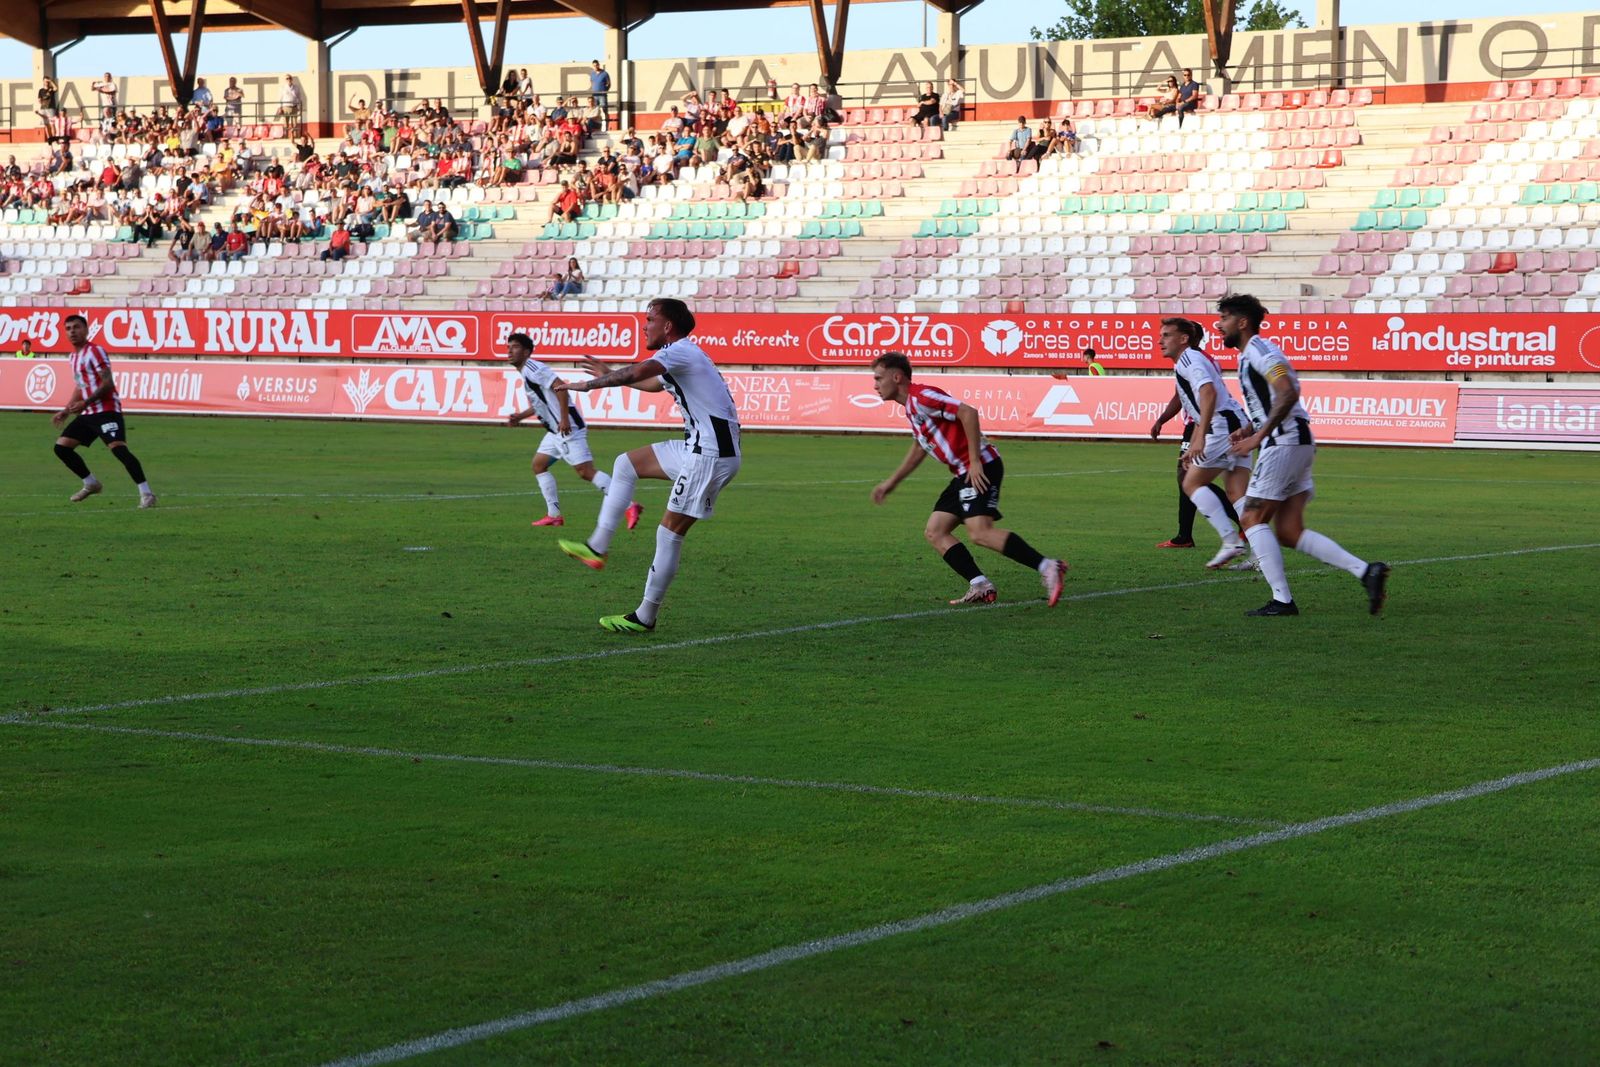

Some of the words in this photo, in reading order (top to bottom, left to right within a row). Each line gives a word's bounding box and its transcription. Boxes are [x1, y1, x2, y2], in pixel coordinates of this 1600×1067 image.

[870, 20, 1548, 105] AYUNTAMIENTO
[104, 309, 195, 351] CAJA
[204, 310, 341, 353] RURAL
[1026, 320, 1151, 329] ORTOPEDIA
[358, 316, 467, 353] AMAQ
[688, 334, 728, 346] orma
[732, 329, 800, 347] diferente
[1023, 333, 1069, 350] tres
[1077, 334, 1153, 350] cruces
[1372, 336, 1388, 350] la
[1392, 325, 1556, 351] industrial
[822, 349, 887, 357] EMBUTIDOS
[1446, 352, 1471, 366] de
[1475, 353, 1556, 368] pinturas
[112, 368, 203, 401] DERACIÓN
[253, 377, 318, 394] VERSUS
[727, 376, 791, 392] RNERA
[258, 395, 310, 403] E-LEARNING
[385, 369, 488, 415] CAJA
[498, 371, 656, 419] RAL
[735, 393, 791, 412] LISTE
[963, 390, 1022, 400] DENTAL
[977, 406, 1020, 420] AULA
[1094, 402, 1185, 421] AISLAPRI
[1299, 396, 1447, 417] VALDERADUEY
[1344, 418, 1393, 427] COMERCIAL
[1395, 419, 1407, 427] DE
[1409, 420, 1447, 428] ZAMORA
[674, 475, 687, 496] 5
